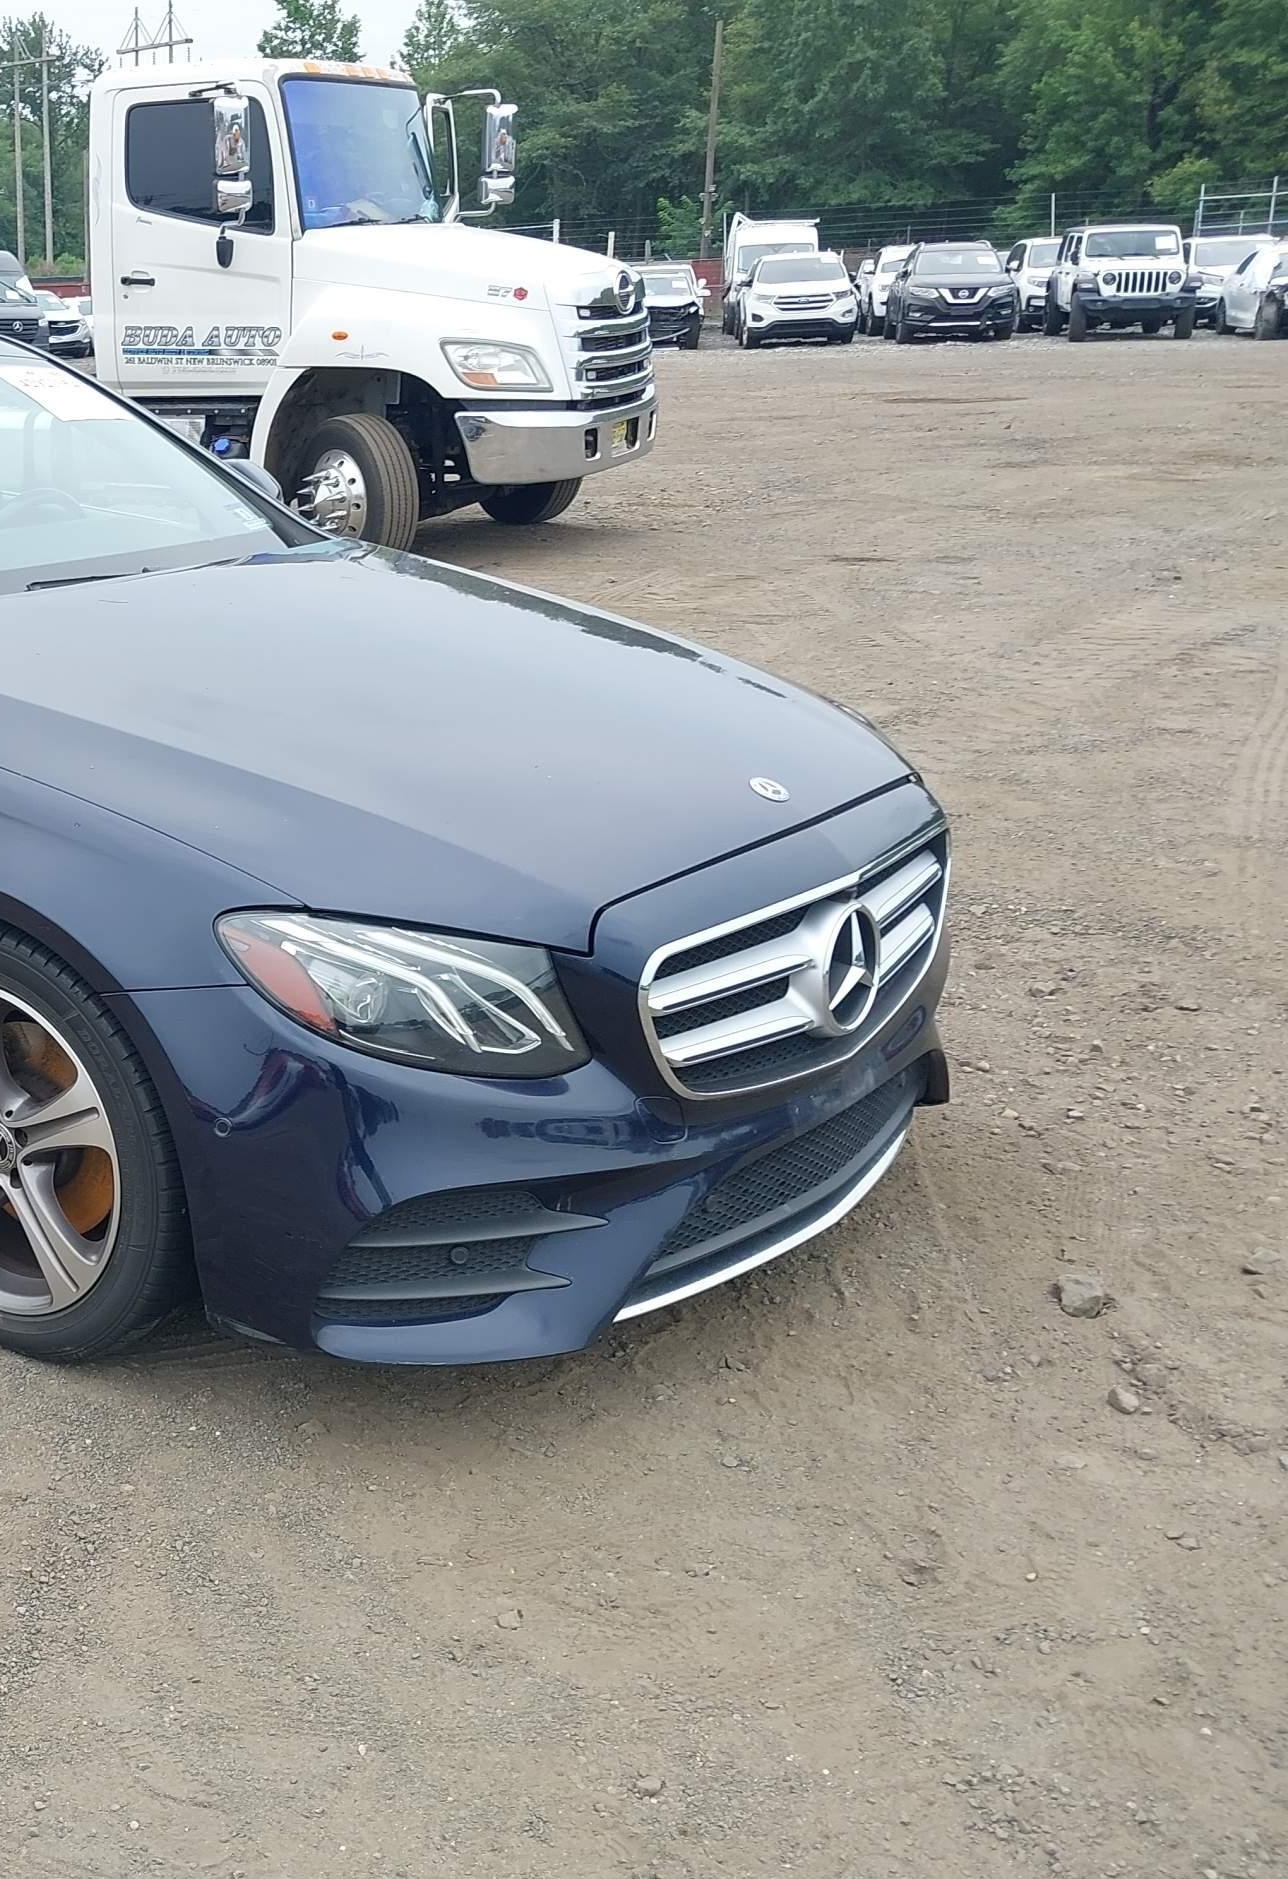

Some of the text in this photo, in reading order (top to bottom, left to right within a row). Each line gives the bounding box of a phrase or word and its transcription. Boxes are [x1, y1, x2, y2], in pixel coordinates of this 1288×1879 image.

[121, 325, 282, 347] BUDA AUTO
[137, 357, 173, 365] BALDWIN
[185, 357, 205, 366] NEW
[206, 358, 255, 366] BRUNSWICK
